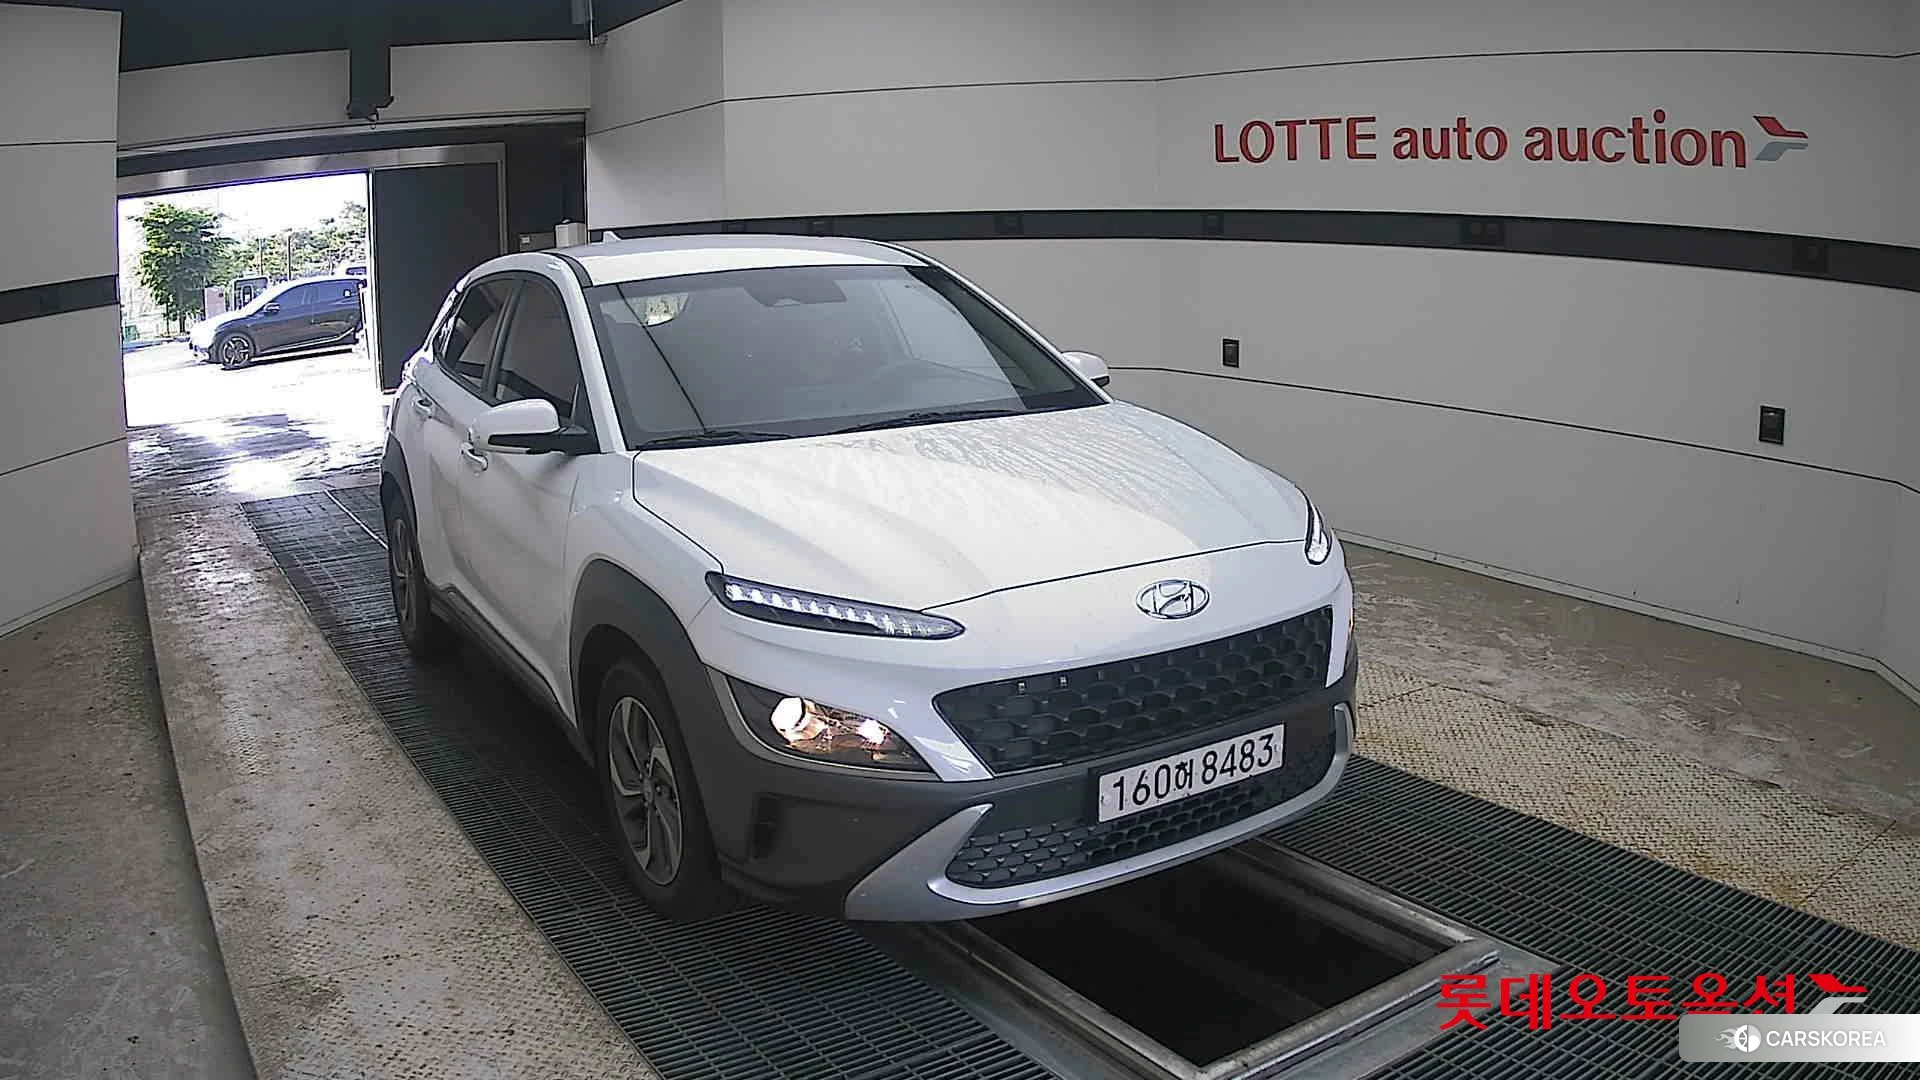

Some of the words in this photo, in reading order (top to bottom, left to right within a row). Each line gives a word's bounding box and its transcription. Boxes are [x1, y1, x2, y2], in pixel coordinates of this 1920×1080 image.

[1214, 116, 1377, 164] LOTTE
[1392, 116, 1508, 161] auto
[1523, 108, 1747, 169] auction
[1112, 758, 1194, 811] 160허
[1201, 732, 1275, 785] 8483
